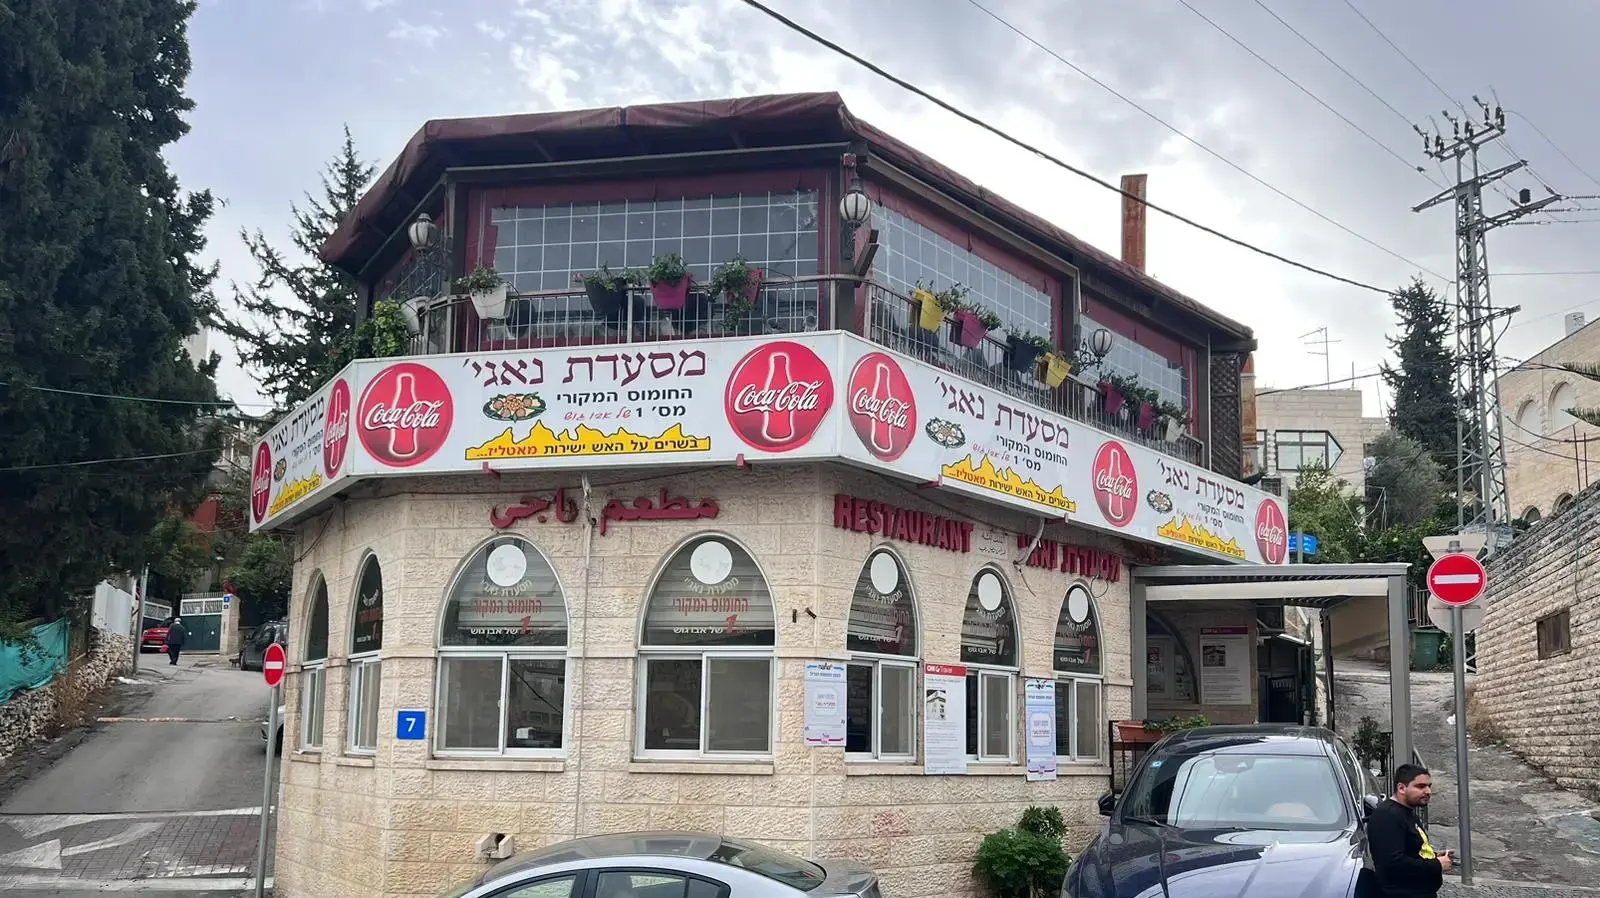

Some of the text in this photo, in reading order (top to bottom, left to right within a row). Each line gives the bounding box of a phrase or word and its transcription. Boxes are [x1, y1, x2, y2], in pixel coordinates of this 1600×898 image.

[562, 350, 706, 387] מסעדת
[556, 388, 693, 407] החומוס המקורי
[735, 381, 824, 413] Coca-Cola
[364, 400, 445, 431] Coca-Cola
[635, 407, 643, 418] 1
[853, 387, 910, 428] Coca-Cola
[994, 403, 1069, 449] מסעדת
[544, 443, 586, 454] ישירות
[592, 442, 624, 453] האש
[630, 439, 649, 451] על
[654, 438, 699, 450] בשרים
[996, 435, 1068, 466] החומוס המקורי
[1013, 455, 1018, 465] 1
[989, 478, 1013, 492] ישירות
[1096, 468, 1133, 499] Coca-Cola
[1015, 486, 1033, 498] האש
[1035, 490, 1046, 502] על
[1195, 476, 1245, 509] מסעדת
[1048, 496, 1070, 509] בשרים
[601, 487, 720, 536] مطعم
[834, 493, 975, 553] RESTAURANT
[1060, 544, 1122, 583] מסעדת
[705, 577, 740, 594] מסעדת
[508, 600, 542, 614] החומוס
[672, 598, 749, 616] החומוס המקורי
[504, 626, 518, 635] של
[708, 625, 724, 634] של
[895, 626, 903, 643] 1
[998, 639, 1005, 655] 1
[405, 717, 416, 732] 7
